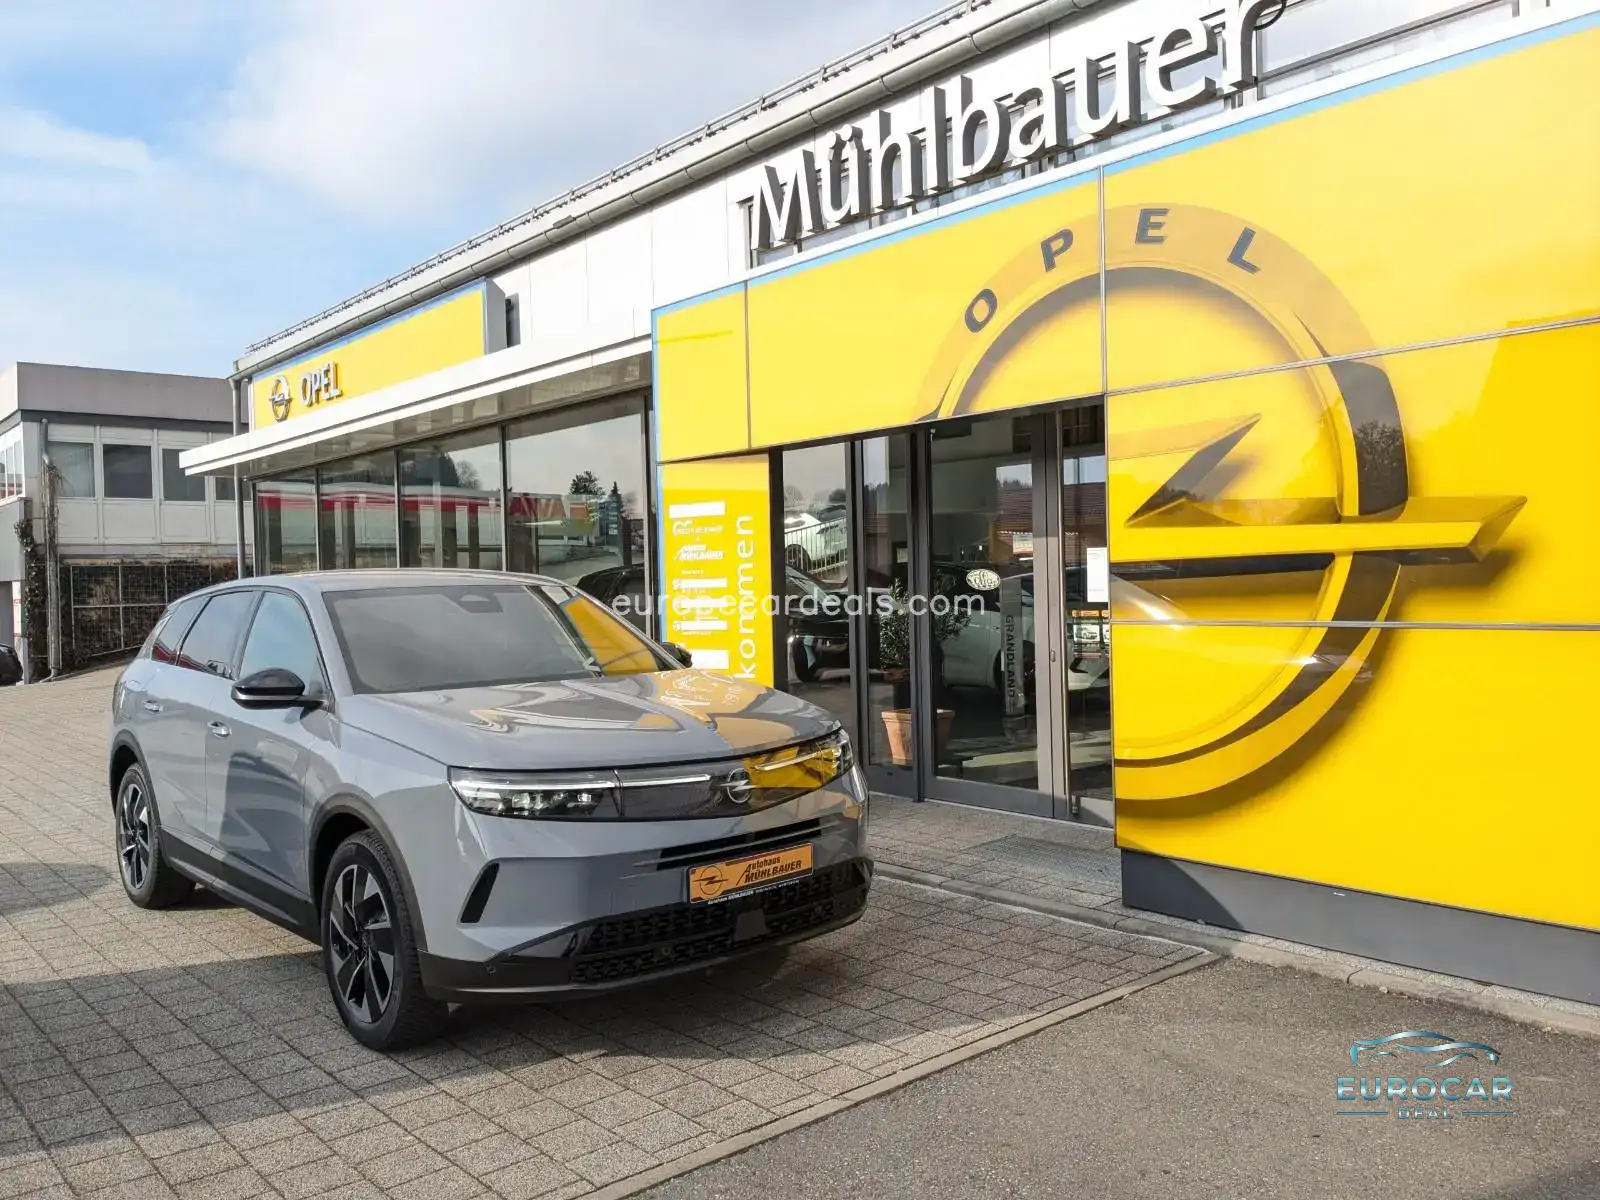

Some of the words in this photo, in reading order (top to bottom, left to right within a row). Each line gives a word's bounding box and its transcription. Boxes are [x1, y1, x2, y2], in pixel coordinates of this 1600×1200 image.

[750, 0, 1284, 251] Mühlbauer
[964, 208, 1261, 334] OPEL
[300, 361, 342, 407] OPEL
[1005, 614, 1017, 698] GRANDLAND
[743, 860, 802, 884] MÜHLBAUER
